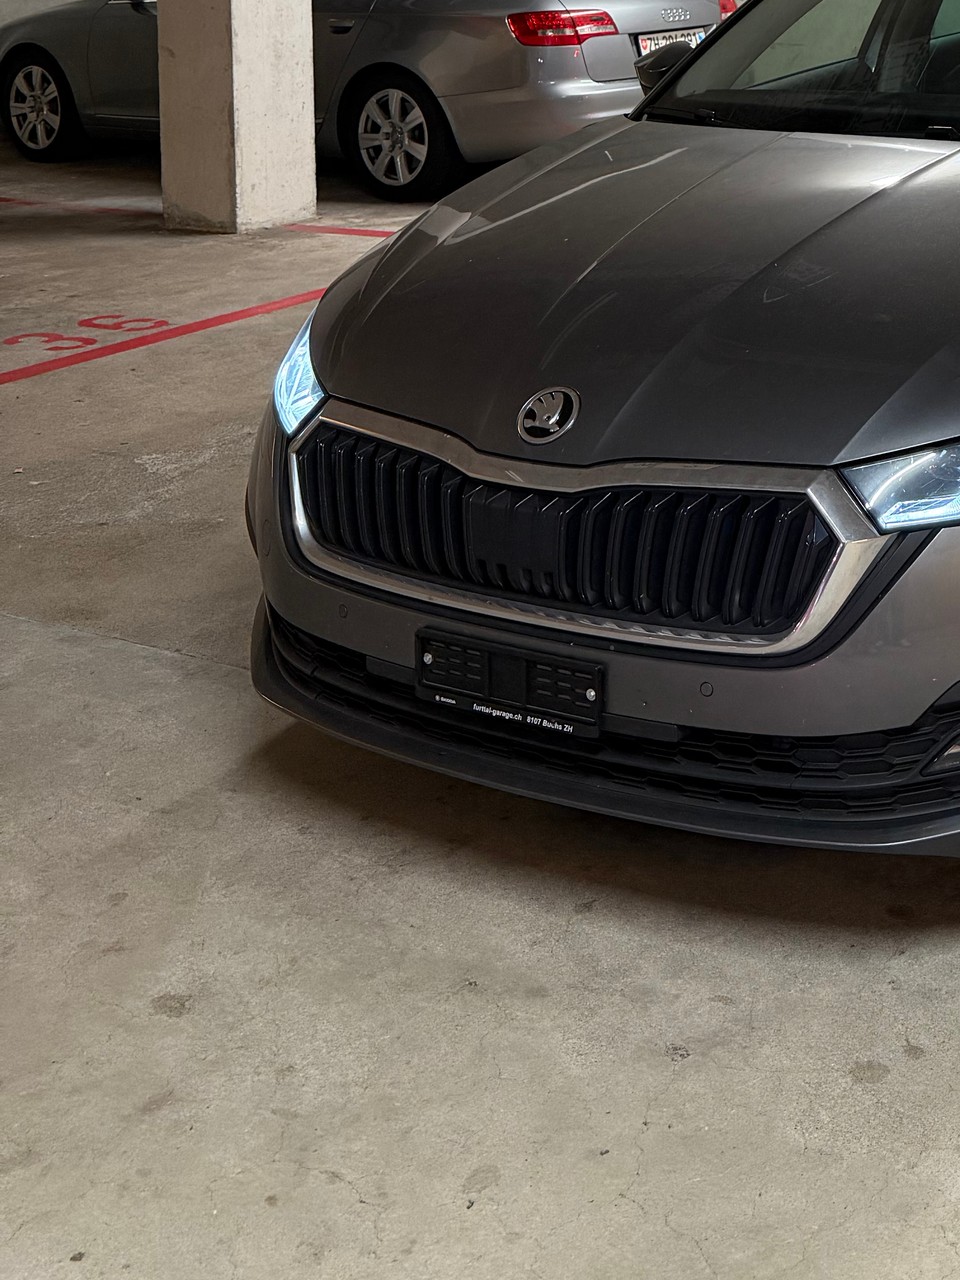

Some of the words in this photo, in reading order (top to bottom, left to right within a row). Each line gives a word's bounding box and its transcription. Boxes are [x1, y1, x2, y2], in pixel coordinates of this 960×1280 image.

[3, 314, 169, 351] 36
[526, 716, 541, 725] 8107
[563, 724, 573, 733] ZH
